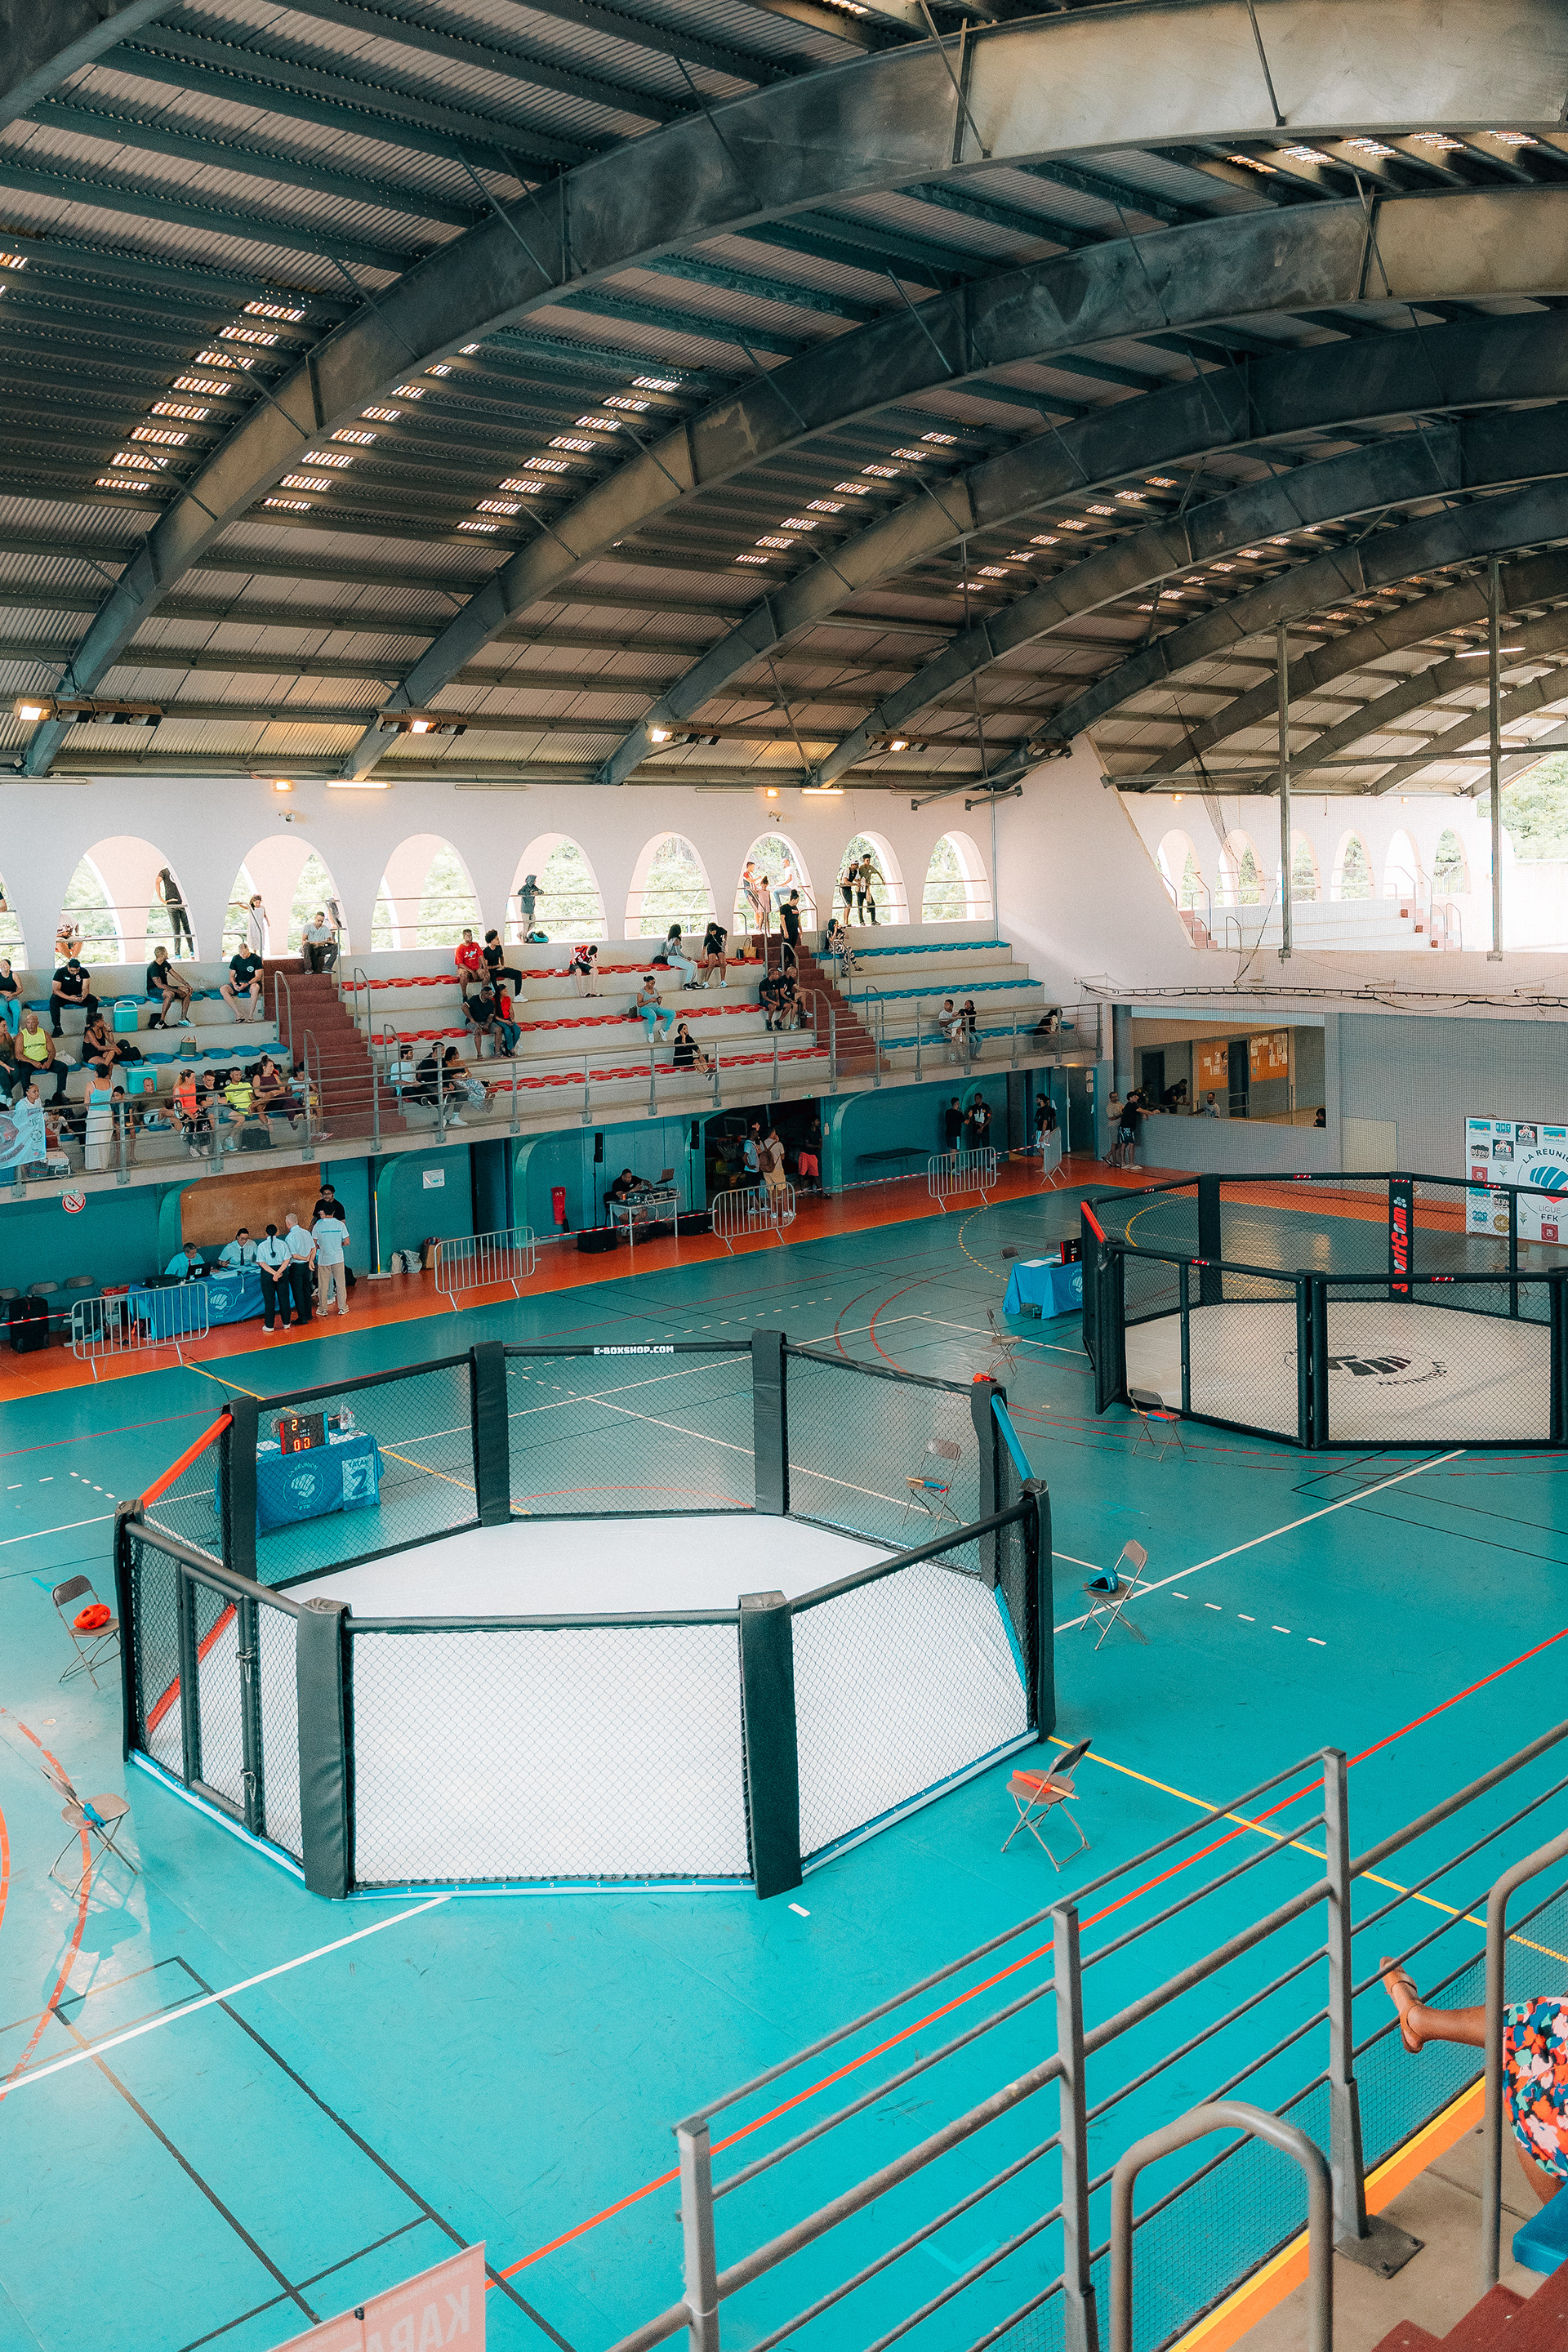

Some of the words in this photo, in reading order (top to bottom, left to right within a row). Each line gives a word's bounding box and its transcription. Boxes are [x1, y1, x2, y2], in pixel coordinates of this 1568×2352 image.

[1522, 1153, 1535, 1164] LA
[1539, 1205, 1561, 1214] LIGUE
[593, 1345, 675, 1355] E-BOXSHOP.COM
[291, 1419, 298, 1431] 2
[351, 1468, 368, 1495] 2
